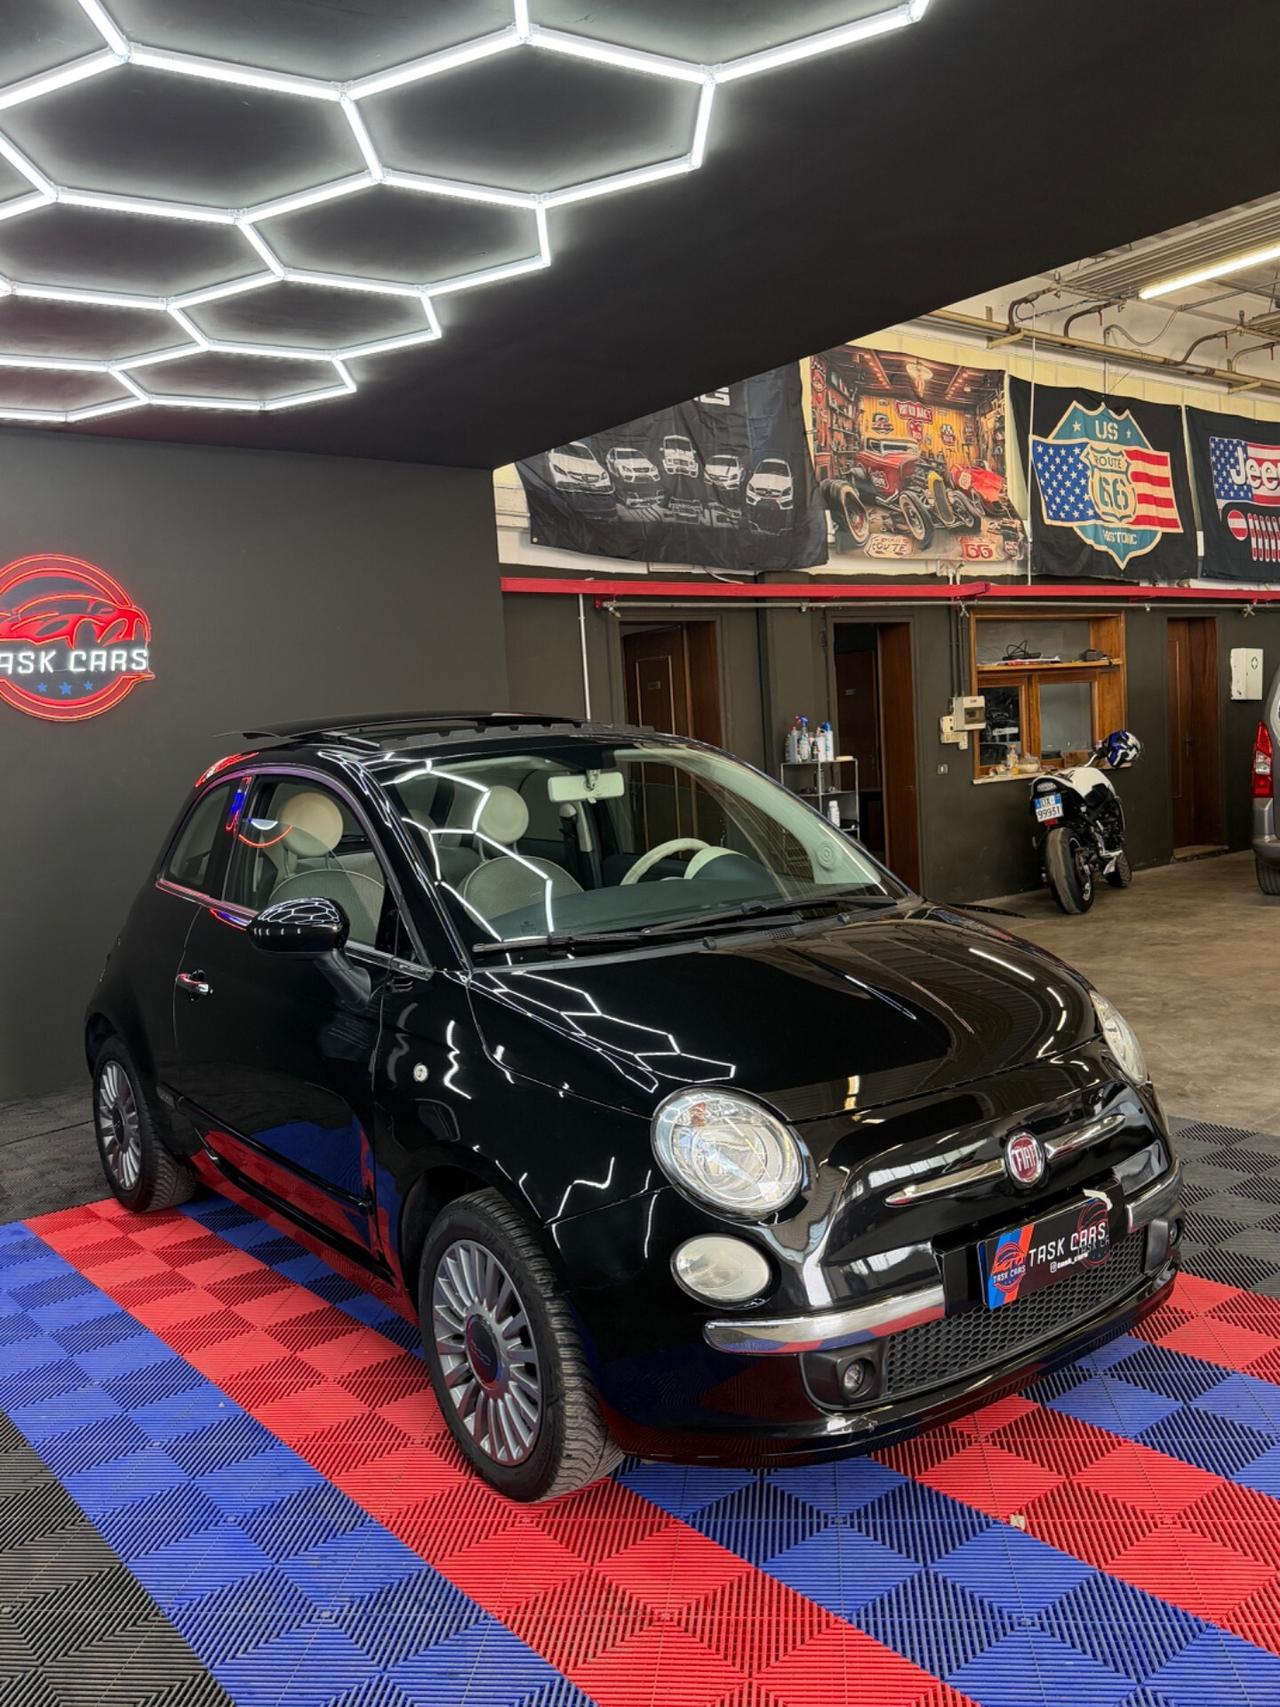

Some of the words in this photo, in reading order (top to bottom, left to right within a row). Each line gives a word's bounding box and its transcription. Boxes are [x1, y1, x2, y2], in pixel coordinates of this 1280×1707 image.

[1095, 419, 1119, 441] US
[1093, 455, 1122, 469] ROUTE
[1230, 446, 1280, 491] Jee
[1098, 476, 1129, 511] 66
[965, 543, 993, 559] 66
[0, 650, 57, 675] ASK
[69, 649, 149, 673] CARS
[1011, 1145, 1036, 1171] FIAT
[1029, 1237, 1066, 1268] TASK
[1070, 1222, 1107, 1251] CARS
[993, 1271, 1009, 1284] TASK
[1010, 1264, 1026, 1277] CARS
